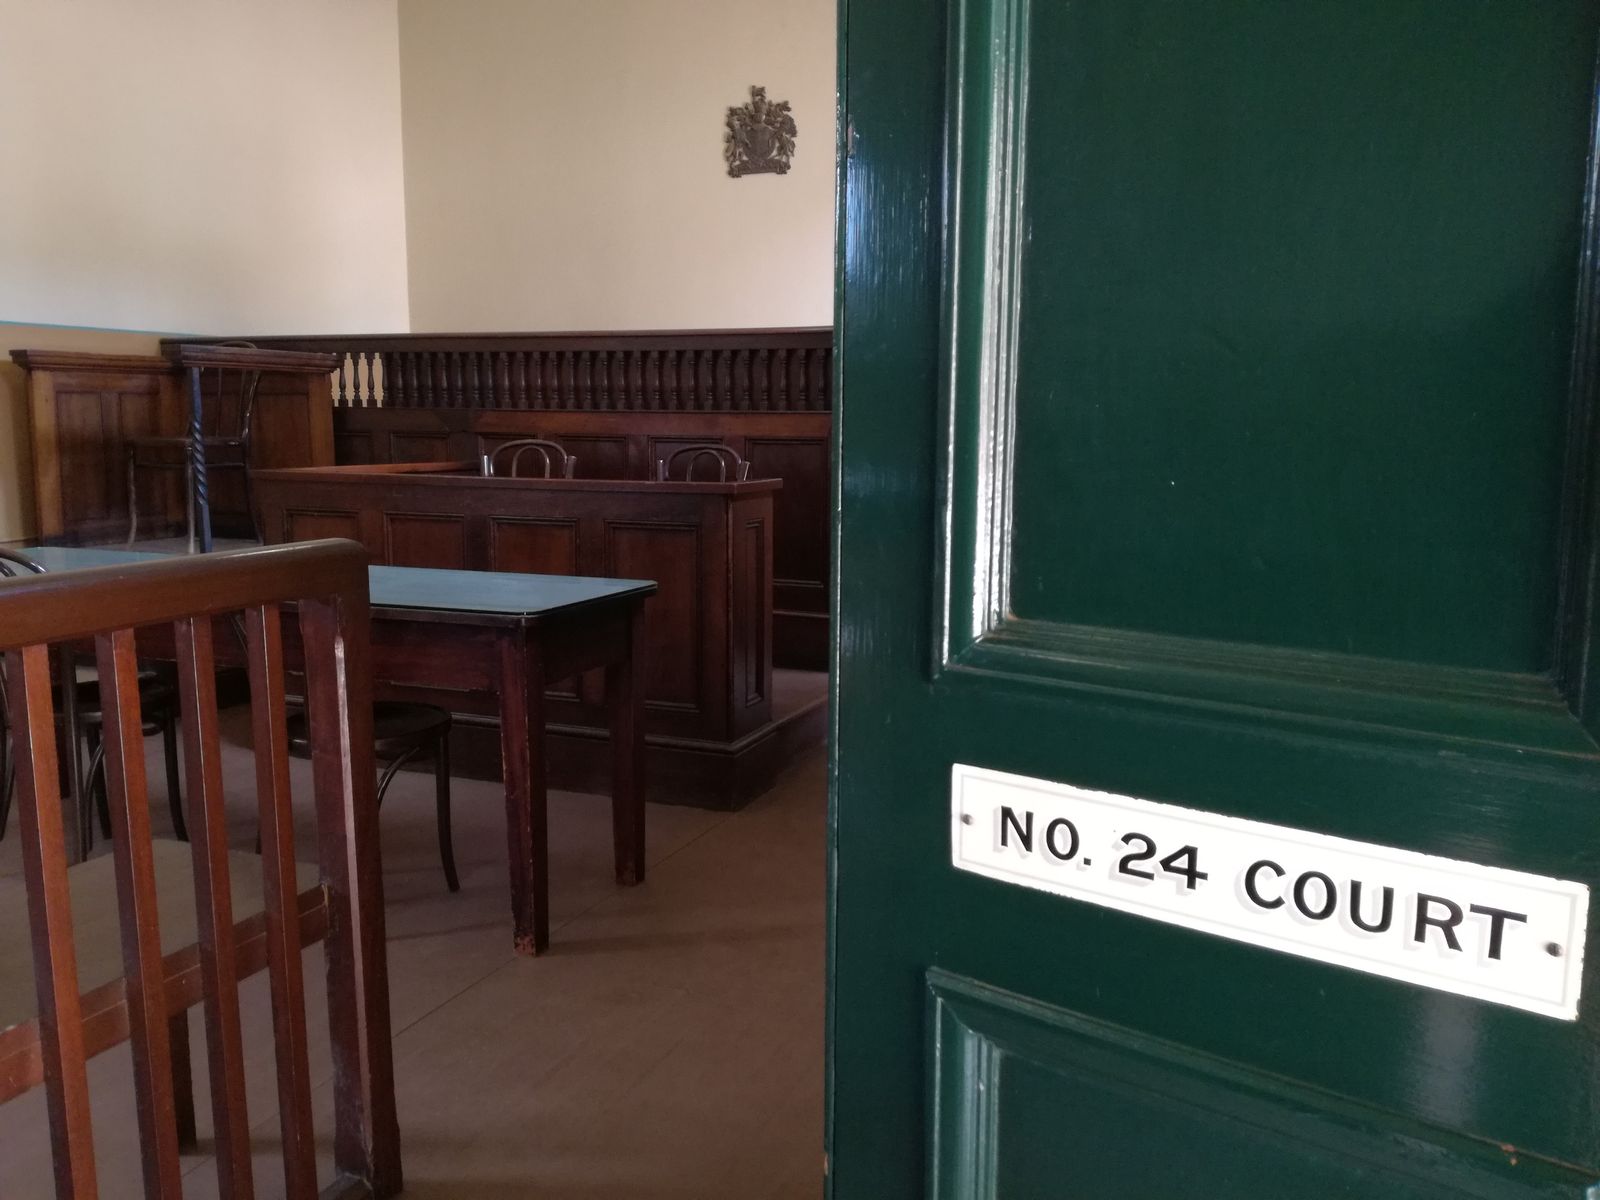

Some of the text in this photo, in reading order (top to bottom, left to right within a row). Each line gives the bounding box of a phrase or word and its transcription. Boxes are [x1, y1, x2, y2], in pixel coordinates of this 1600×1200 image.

[1000, 805, 1527, 960] NO. 24 COURT
